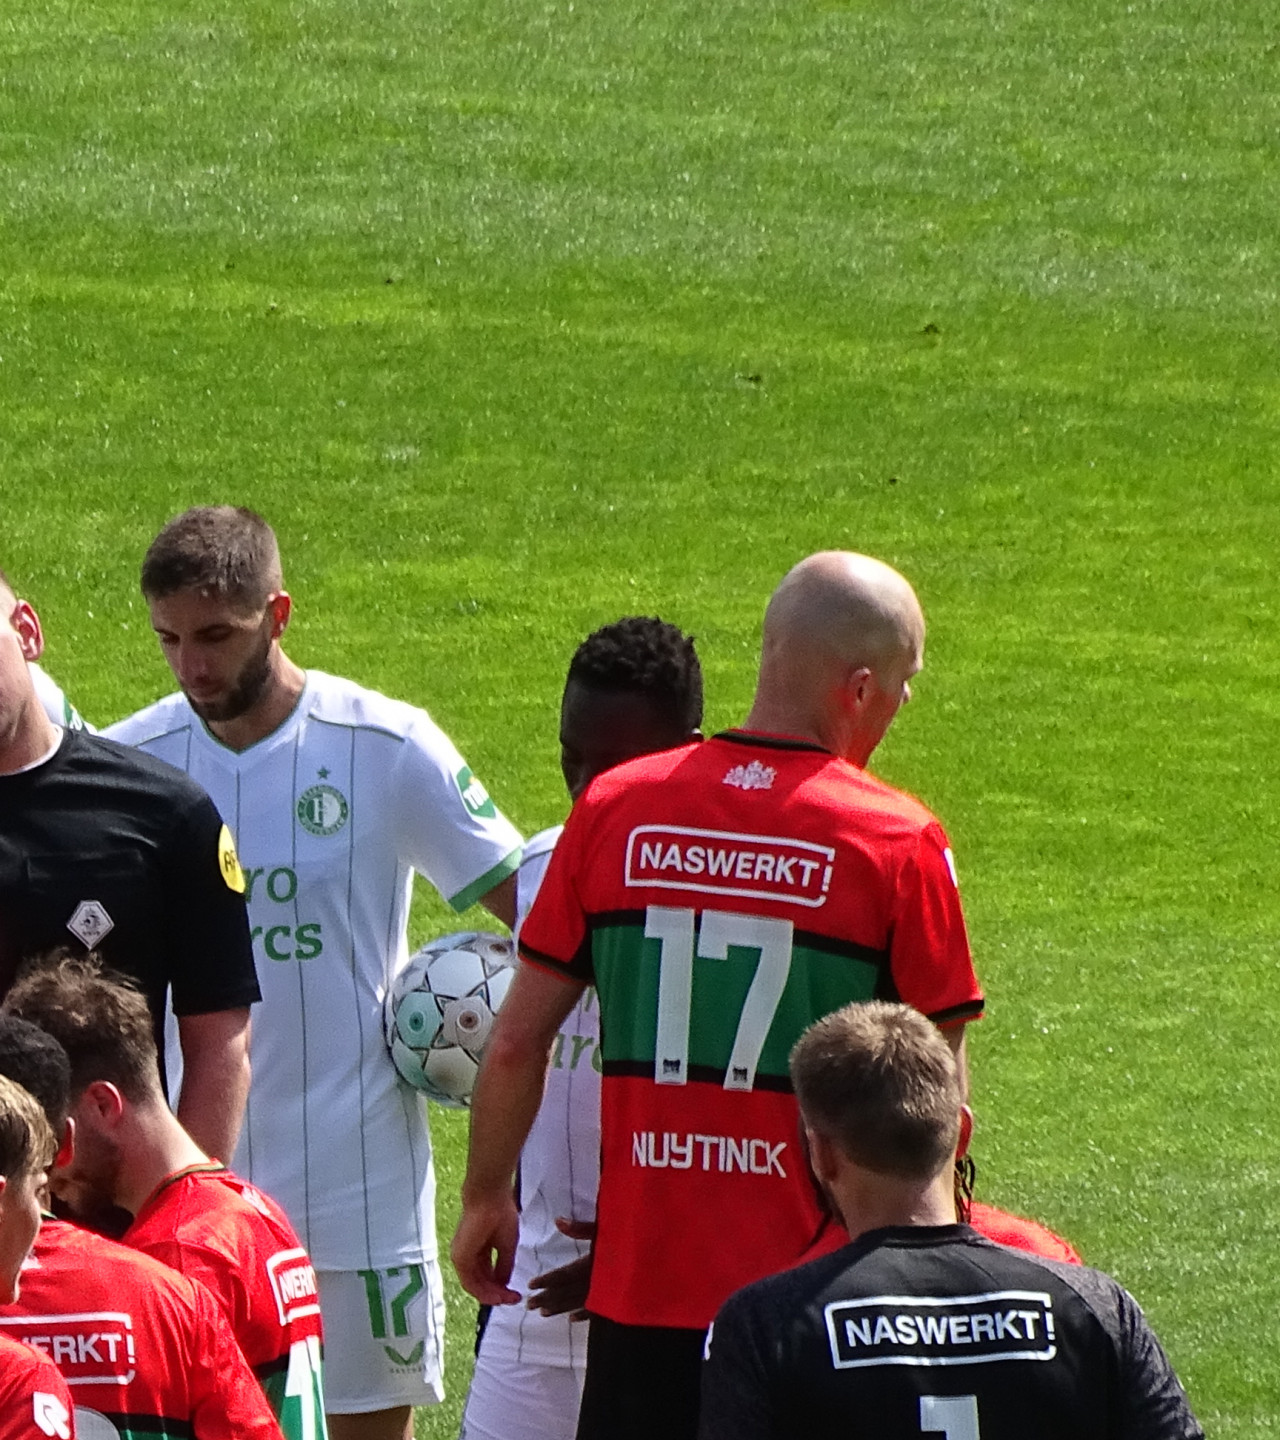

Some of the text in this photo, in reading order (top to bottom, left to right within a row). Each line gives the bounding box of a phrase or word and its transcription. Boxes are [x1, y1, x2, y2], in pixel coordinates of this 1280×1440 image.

[243, 866, 298, 904] ro
[639, 841, 833, 892] NASWERKT!
[250, 922, 324, 962] rcs
[644, 905, 794, 1092] 17
[632, 1131, 789, 1179] NUYTINCK
[844, 1310, 1057, 1348] NASWERKT!
